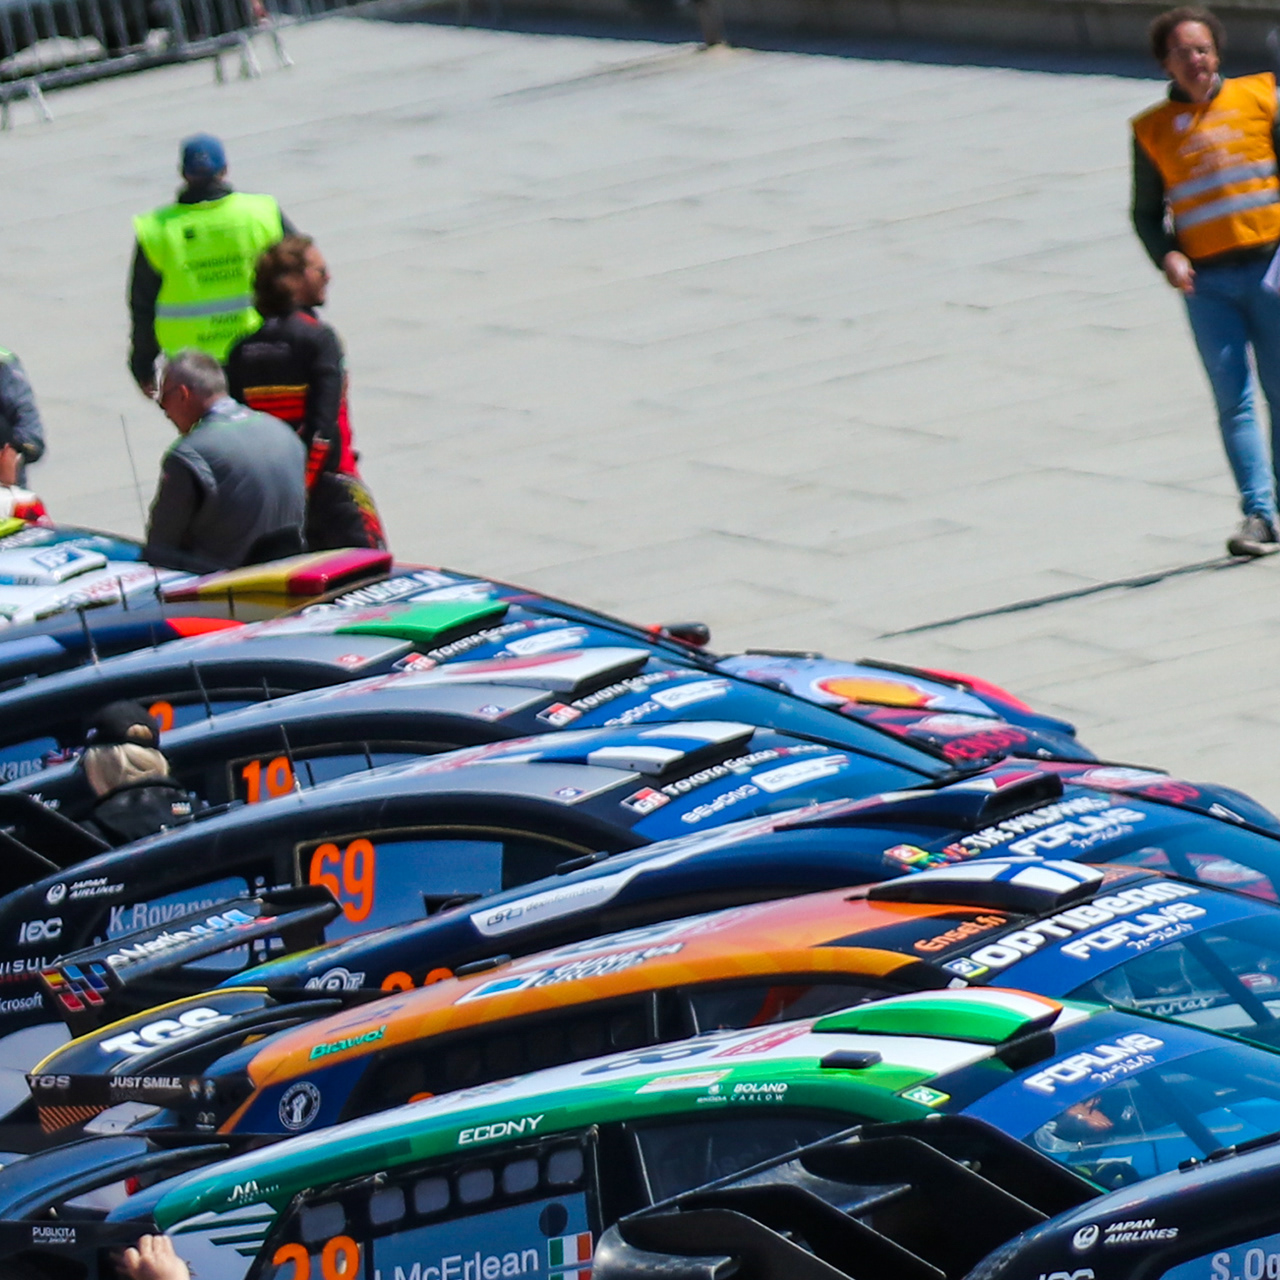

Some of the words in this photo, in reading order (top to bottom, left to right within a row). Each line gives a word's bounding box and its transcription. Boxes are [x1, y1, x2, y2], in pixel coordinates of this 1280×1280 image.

[110, 1077, 141, 1089] JUST
[1105, 1218, 1156, 1233] JAPAN
[1104, 1227, 1179, 1244] AIRLINES
